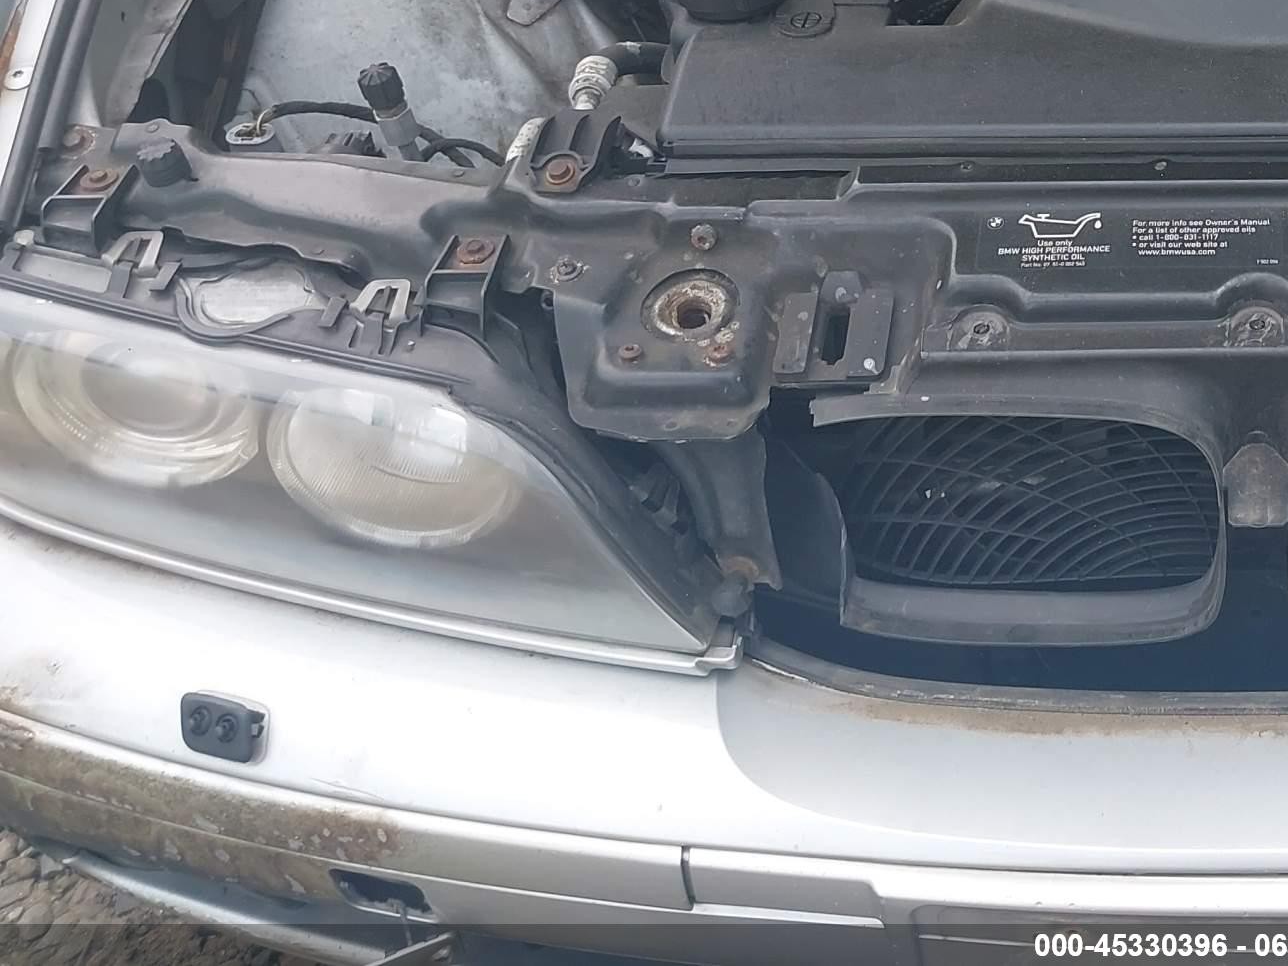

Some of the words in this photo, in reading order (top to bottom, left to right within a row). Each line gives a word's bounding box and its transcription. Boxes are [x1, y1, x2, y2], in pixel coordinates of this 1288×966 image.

[1240, 218, 1270, 226] Manual
[1155, 226, 1168, 234] list
[1202, 226, 1239, 234] approved
[1037, 239, 1054, 247] Use
[1055, 239, 1073, 247] only
[998, 247, 1020, 255] BMW
[1022, 246, 1043, 254] HIGH
[1045, 245, 1111, 254] PERFORMANCE
[1138, 248, 1216, 256] www.bmwusa.com
[1021, 253, 1069, 262] SYNTHETIC
[1071, 253, 1085, 261] OIL
